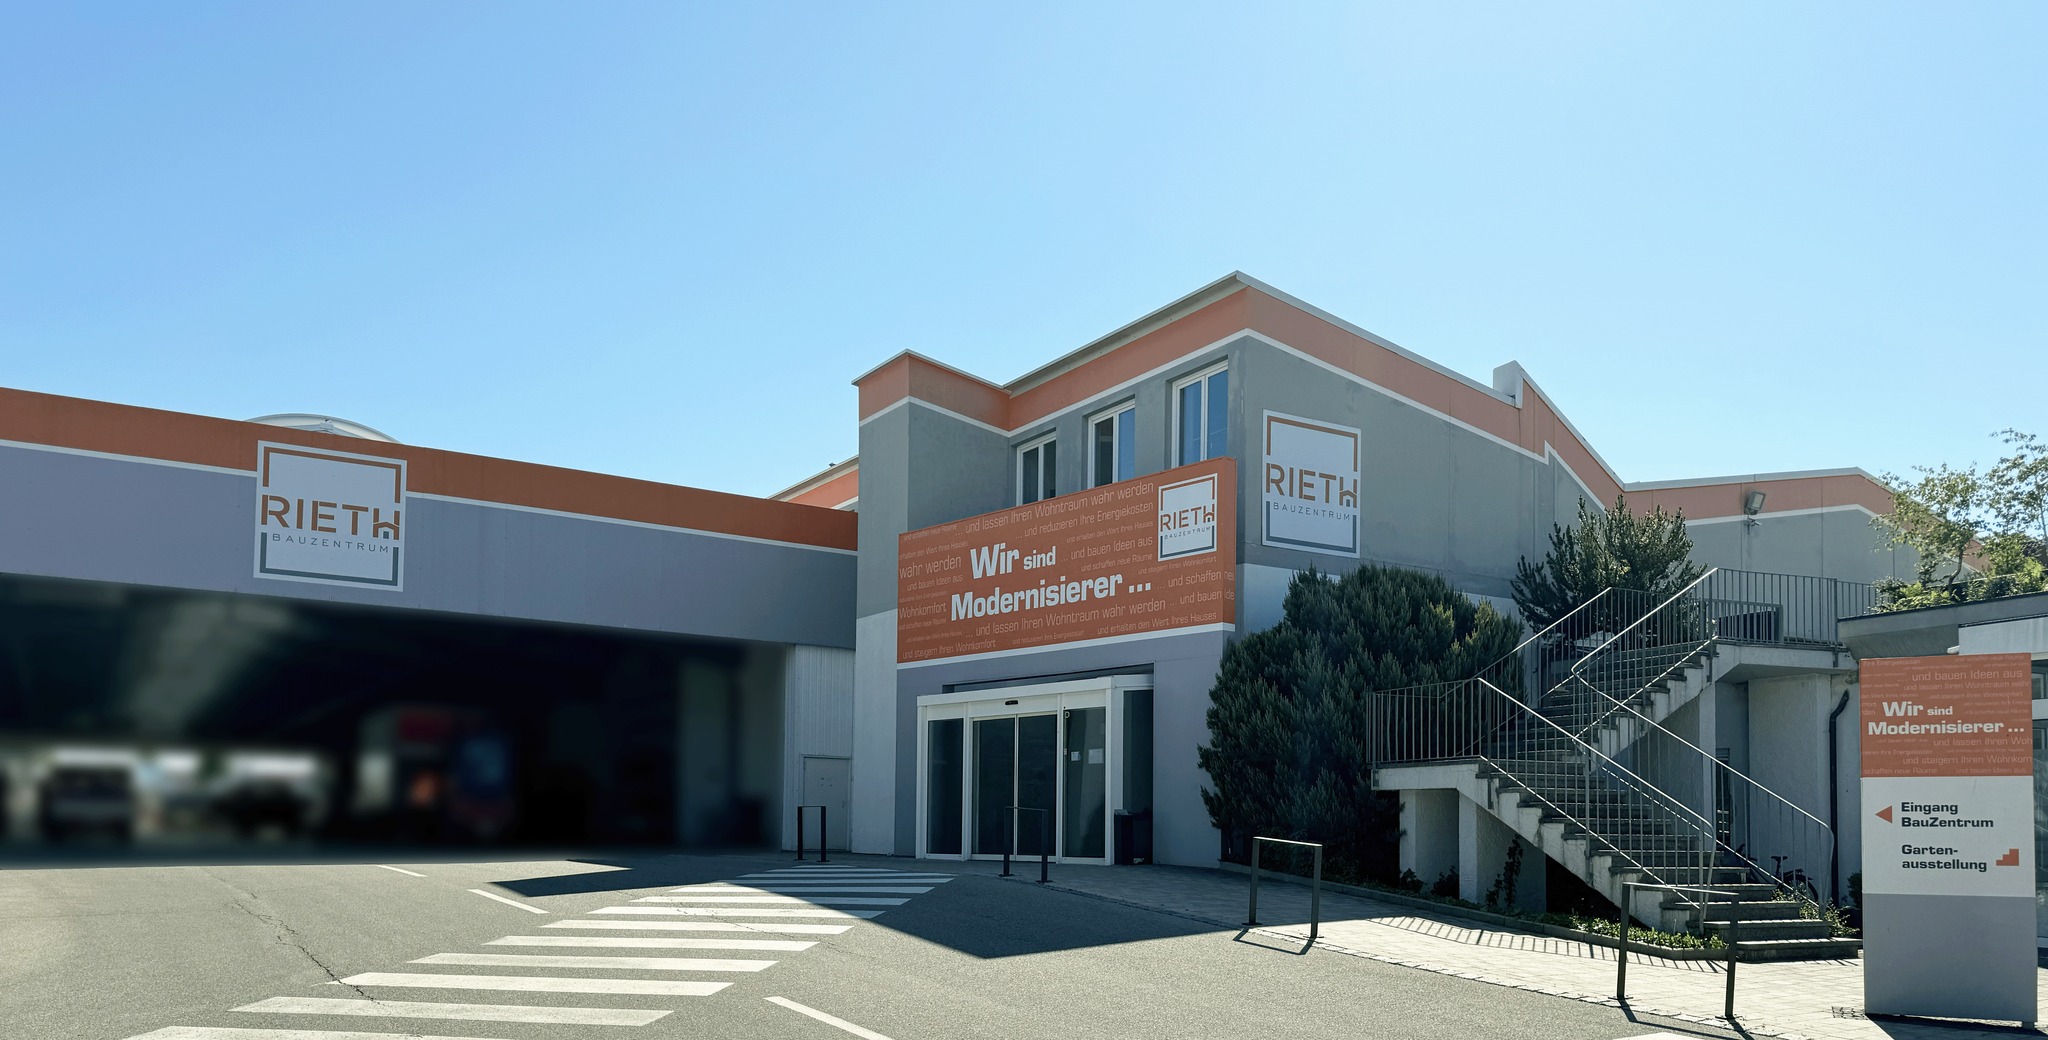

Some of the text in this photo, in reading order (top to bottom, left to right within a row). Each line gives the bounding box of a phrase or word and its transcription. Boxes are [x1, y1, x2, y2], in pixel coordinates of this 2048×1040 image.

[1265, 462, 1357, 508] RIETH
[260, 494, 400, 540] RIETH
[966, 519, 980, 534] und
[982, 515, 1009, 530] lassen
[1011, 509, 1032, 524] Ihren
[1035, 497, 1088, 518] Wohntraum
[1090, 490, 1115, 506] wahr
[1117, 482, 1154, 500] werden
[1160, 503, 1215, 532] RIETH
[1272, 501, 1351, 521] BAUZENTRUM
[1024, 525, 1038, 537] und
[1040, 518, 1078, 534] reduzieren
[1080, 514, 1095, 525] Ihre
[1097, 502, 1154, 521] Energiekosten
[272, 533, 390, 553] BAUZENTRUM
[1070, 546, 1085, 561] und
[1087, 543, 1111, 558] bauen
[1113, 538, 1136, 552] Ideen
[1137, 536, 1153, 548] aus
[899, 554, 962, 579] wahr werden
[969, 541, 1057, 580] Wir sind
[1081, 564, 1092, 573] und
[1116, 556, 1131, 566] neue
[906, 582, 917, 592] und
[1168, 574, 1183, 588] und
[1185, 570, 1222, 585] schaffen
[951, 572, 1123, 622] Modernisierer
[899, 602, 947, 619] Wohnkomfort
[976, 622, 990, 637] und
[992, 620, 1019, 635] lassen
[1021, 618, 1043, 631] Ihren
[1045, 609, 1100, 628] Wohntraum
[1101, 603, 1126, 619] wahr
[1129, 598, 1166, 615] werden
[1180, 592, 1195, 605] und
[1197, 590, 1222, 603] bauen
[1097, 612, 1217, 635] und erhalten den Wert Ihres Hauses
[902, 650, 913, 660] und
[955, 640, 997, 653] Wohnkomfort
[1911, 671, 1931, 682] und
[1934, 671, 1967, 681] bauen
[1970, 669, 1999, 680] Ideen
[2003, 670, 2023, 679] aus
[1903, 683, 1917, 691] und
[1881, 700, 1924, 717] Wir
[1926, 705, 1953, 717] sind
[1867, 719, 2005, 736] Modernisierer
[1933, 738, 1950, 747] und
[1952, 738, 1982, 747] lassen
[1985, 736, 2008, 746] Ihren
[1902, 756, 1919, 765] und
[1921, 756, 1958, 766] steigern
[1961, 755, 1984, 764] Ihren
[1901, 801, 1959, 815] Eingang
[1901, 816, 1994, 828] BauZentrum
[1901, 844, 1959, 855] Garten-
[1901, 858, 1988, 873] ausstellung
